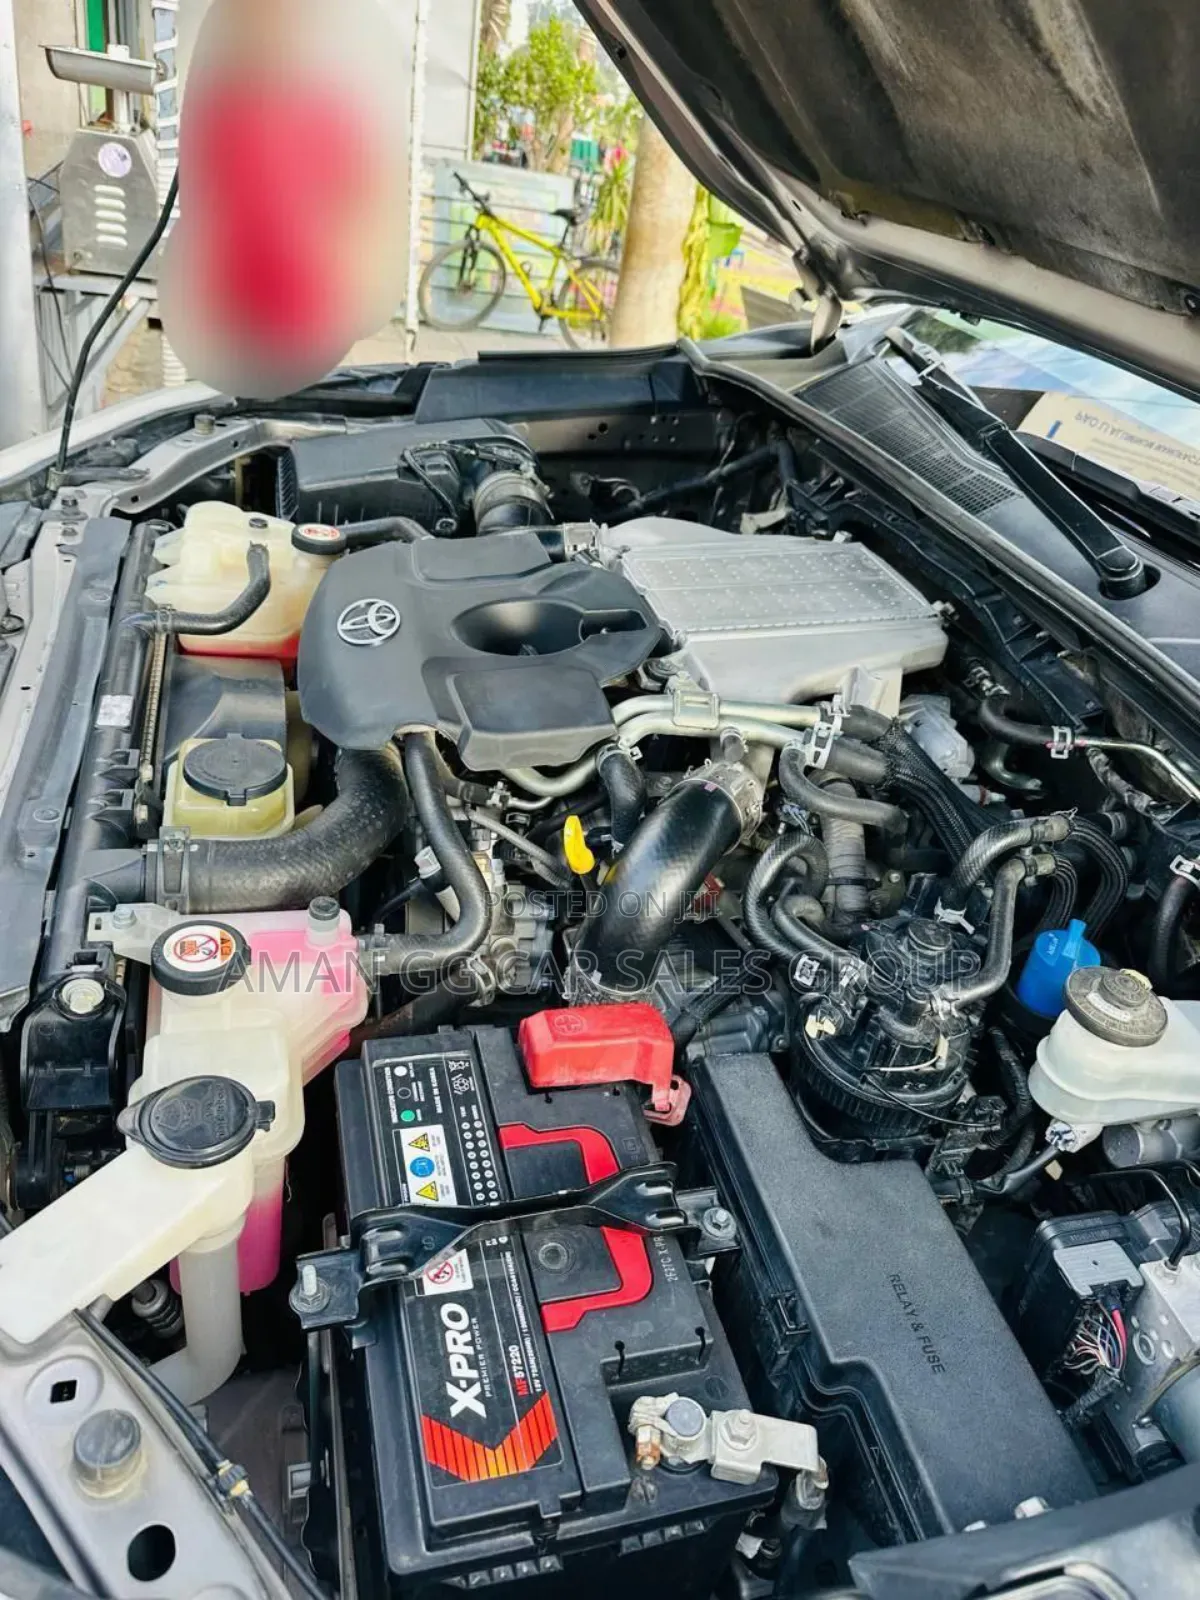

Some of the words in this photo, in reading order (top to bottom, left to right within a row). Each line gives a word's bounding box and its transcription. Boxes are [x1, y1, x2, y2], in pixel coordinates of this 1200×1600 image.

[888, 1273, 919, 1318] RELAY
[470, 1317, 483, 1351] POWER
[911, 1322, 925, 1333] &
[440, 1302, 487, 1419] X-PRO
[478, 1353, 493, 1398] PREMIER
[508, 1344, 530, 1397] MF57220
[917, 1335, 946, 1375] FUSE
